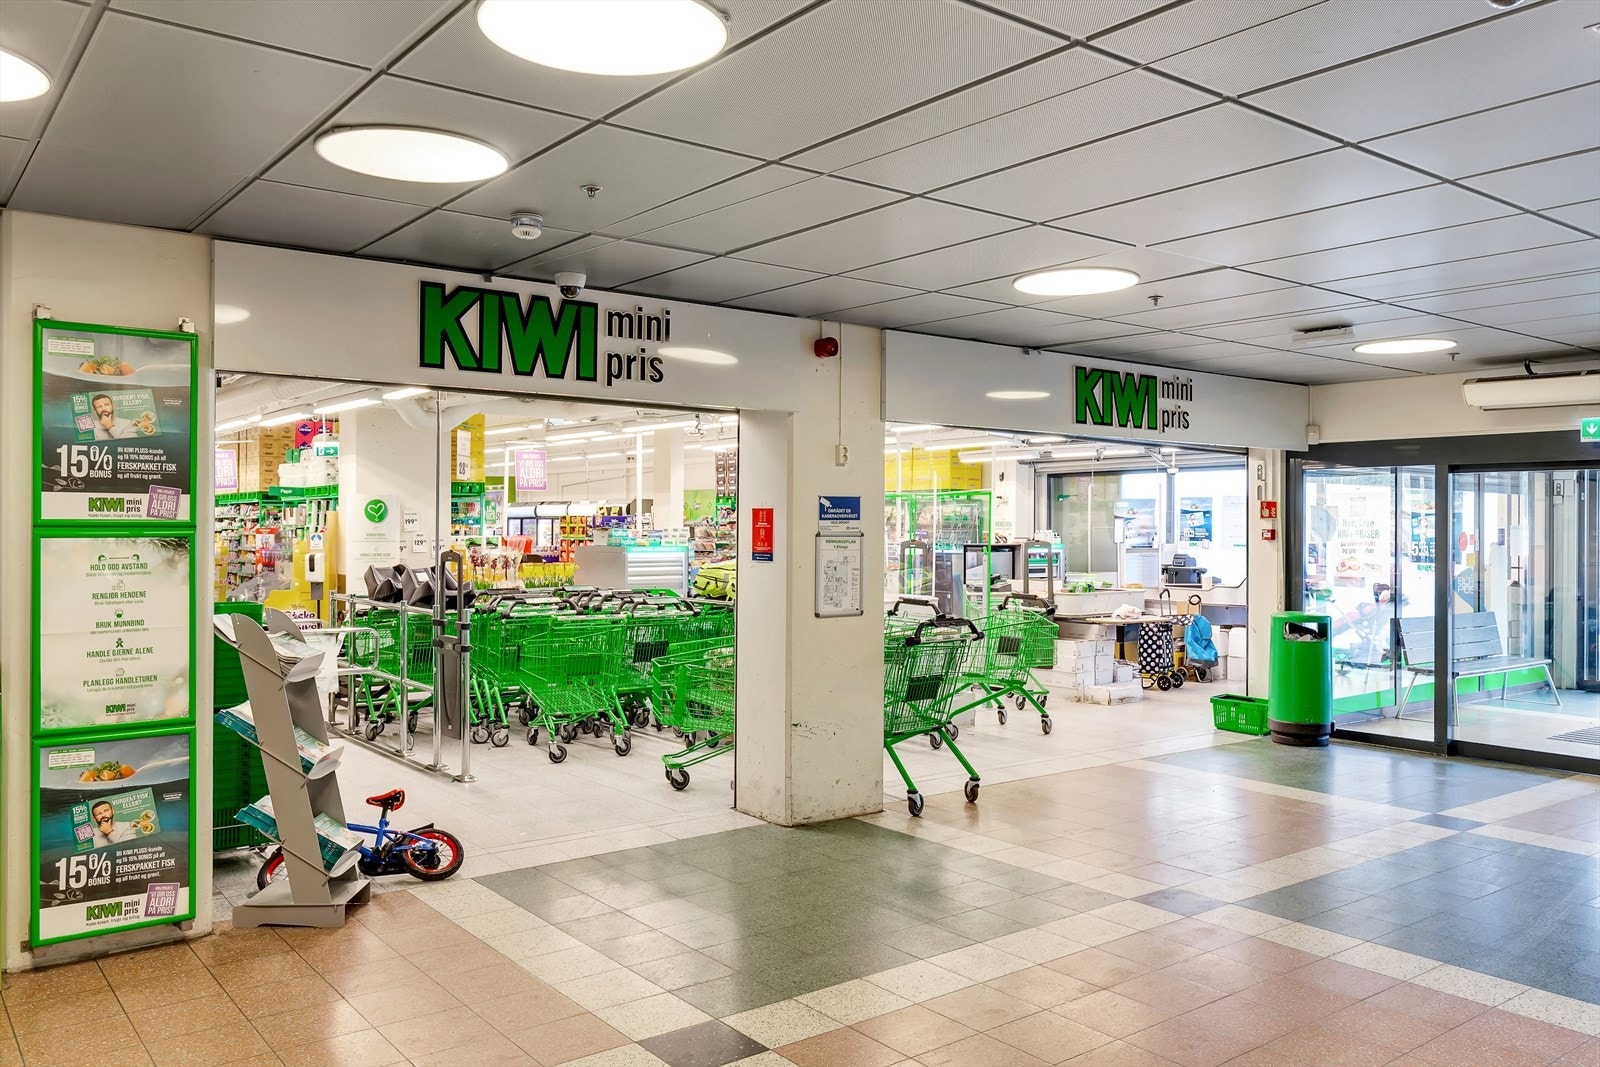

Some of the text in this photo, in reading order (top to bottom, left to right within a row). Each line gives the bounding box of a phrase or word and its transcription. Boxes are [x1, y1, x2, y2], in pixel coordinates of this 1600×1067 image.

[606, 305, 672, 343] mini
[419, 280, 599, 382] KIWI
[605, 347, 665, 387] pris
[1161, 376, 1193, 402] mini
[1074, 366, 1158, 430] KIWI
[1161, 405, 1190, 434] pris
[56, 444, 112, 478] 15%
[117, 462, 177, 471] FERSKPAKKET FISK
[90, 470, 112, 478] BONUS
[217, 466, 234, 477] DRI
[520, 468, 543, 478] ALDRI
[520, 479, 527, 487] PÅ
[88, 497, 125, 512] KIWI
[151, 500, 176, 511] ALDRI
[114, 620, 145, 628] MUNNBIND
[87, 650, 110, 658] HANDLE
[112, 648, 133, 656] GJERNE
[83, 675, 157, 687] PLANLEGG HANDLETUREN
[106, 704, 126, 713] KIWI
[72, 806, 88, 814] 15%
[55, 852, 112, 890] 15%
[116, 858, 176, 874] FERSKPAKKET FISK
[88, 876, 111, 887] BONUS
[124, 899, 140, 908] mini
[150, 896, 174, 907] ALDRI
[86, 901, 123, 921] KIWI
[124, 907, 138, 916] pris
[148, 906, 156, 914] PÅ
